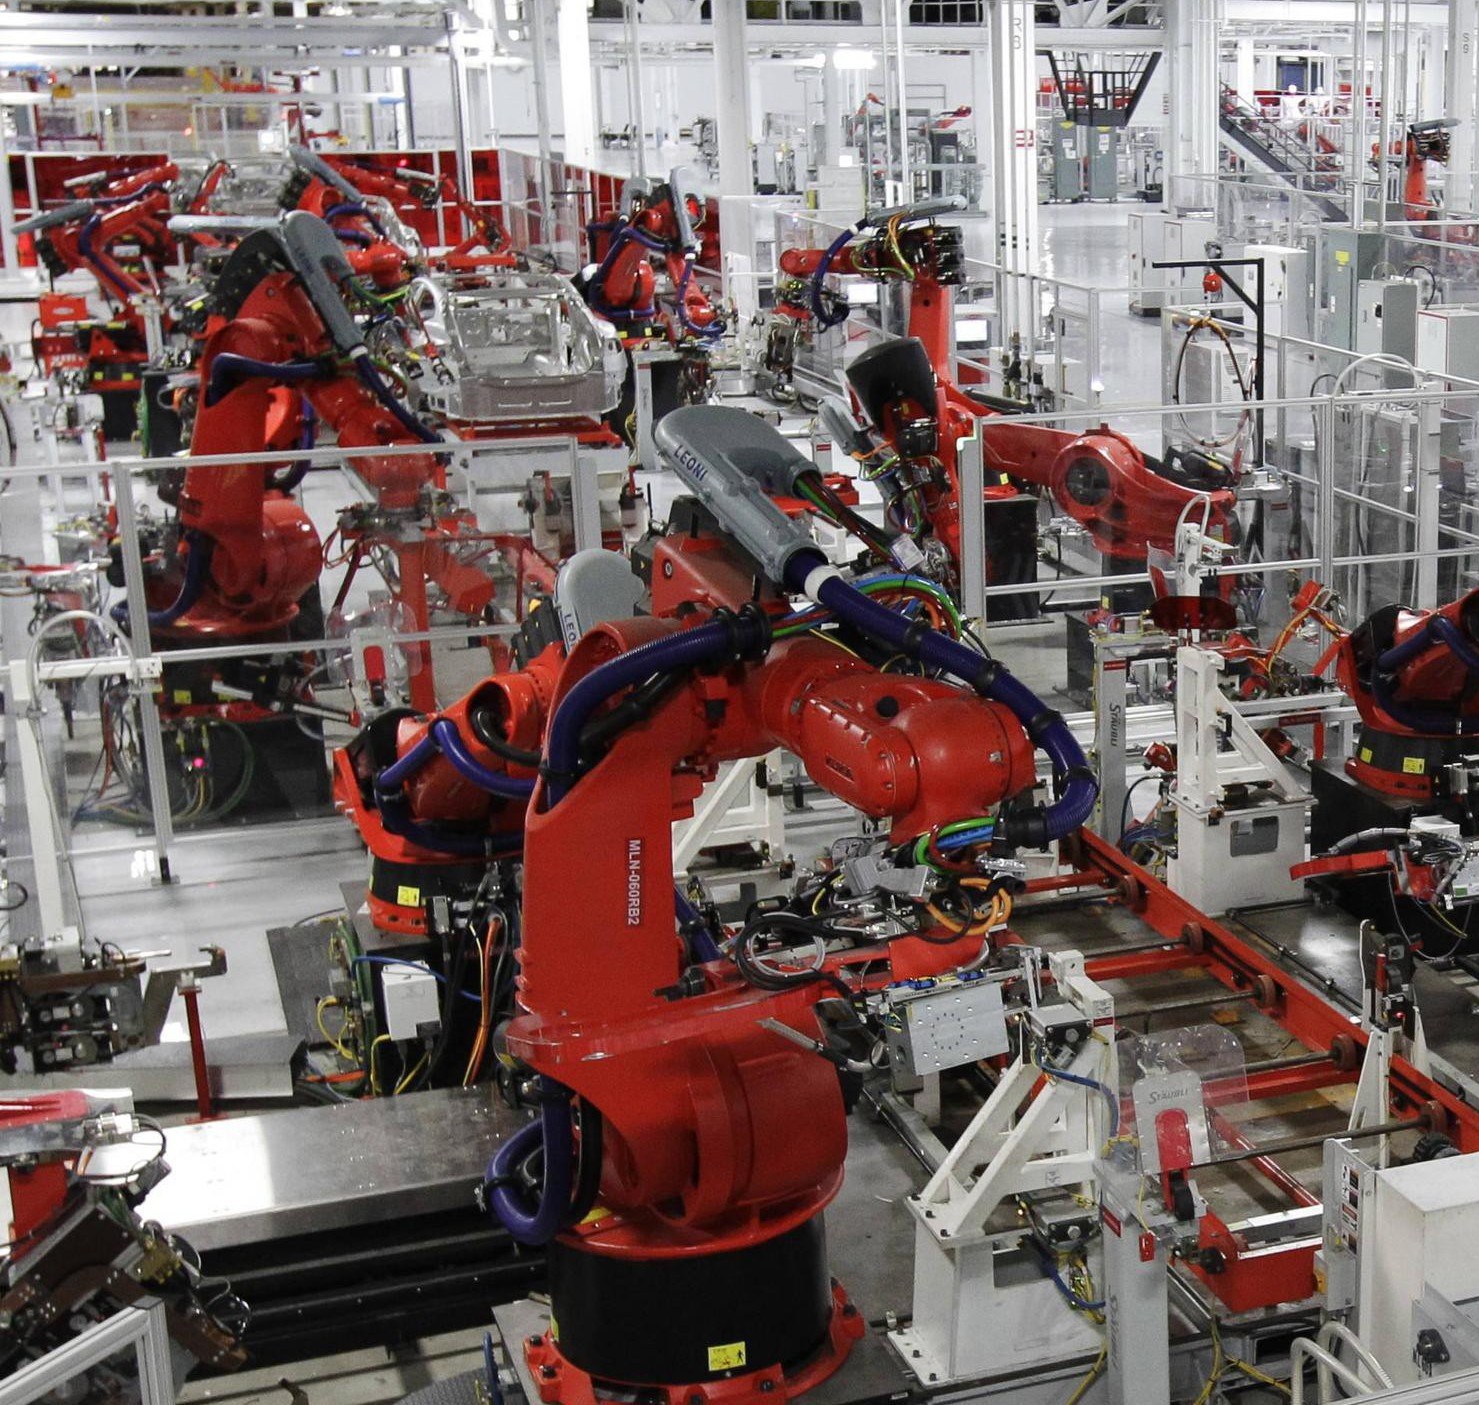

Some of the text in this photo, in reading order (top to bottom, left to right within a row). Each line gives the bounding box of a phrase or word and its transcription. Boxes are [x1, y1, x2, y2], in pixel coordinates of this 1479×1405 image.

[673, 444, 709, 482] LEONI
[564, 613, 578, 646] LEO
[627, 839, 641, 926] MLN-060RB2
